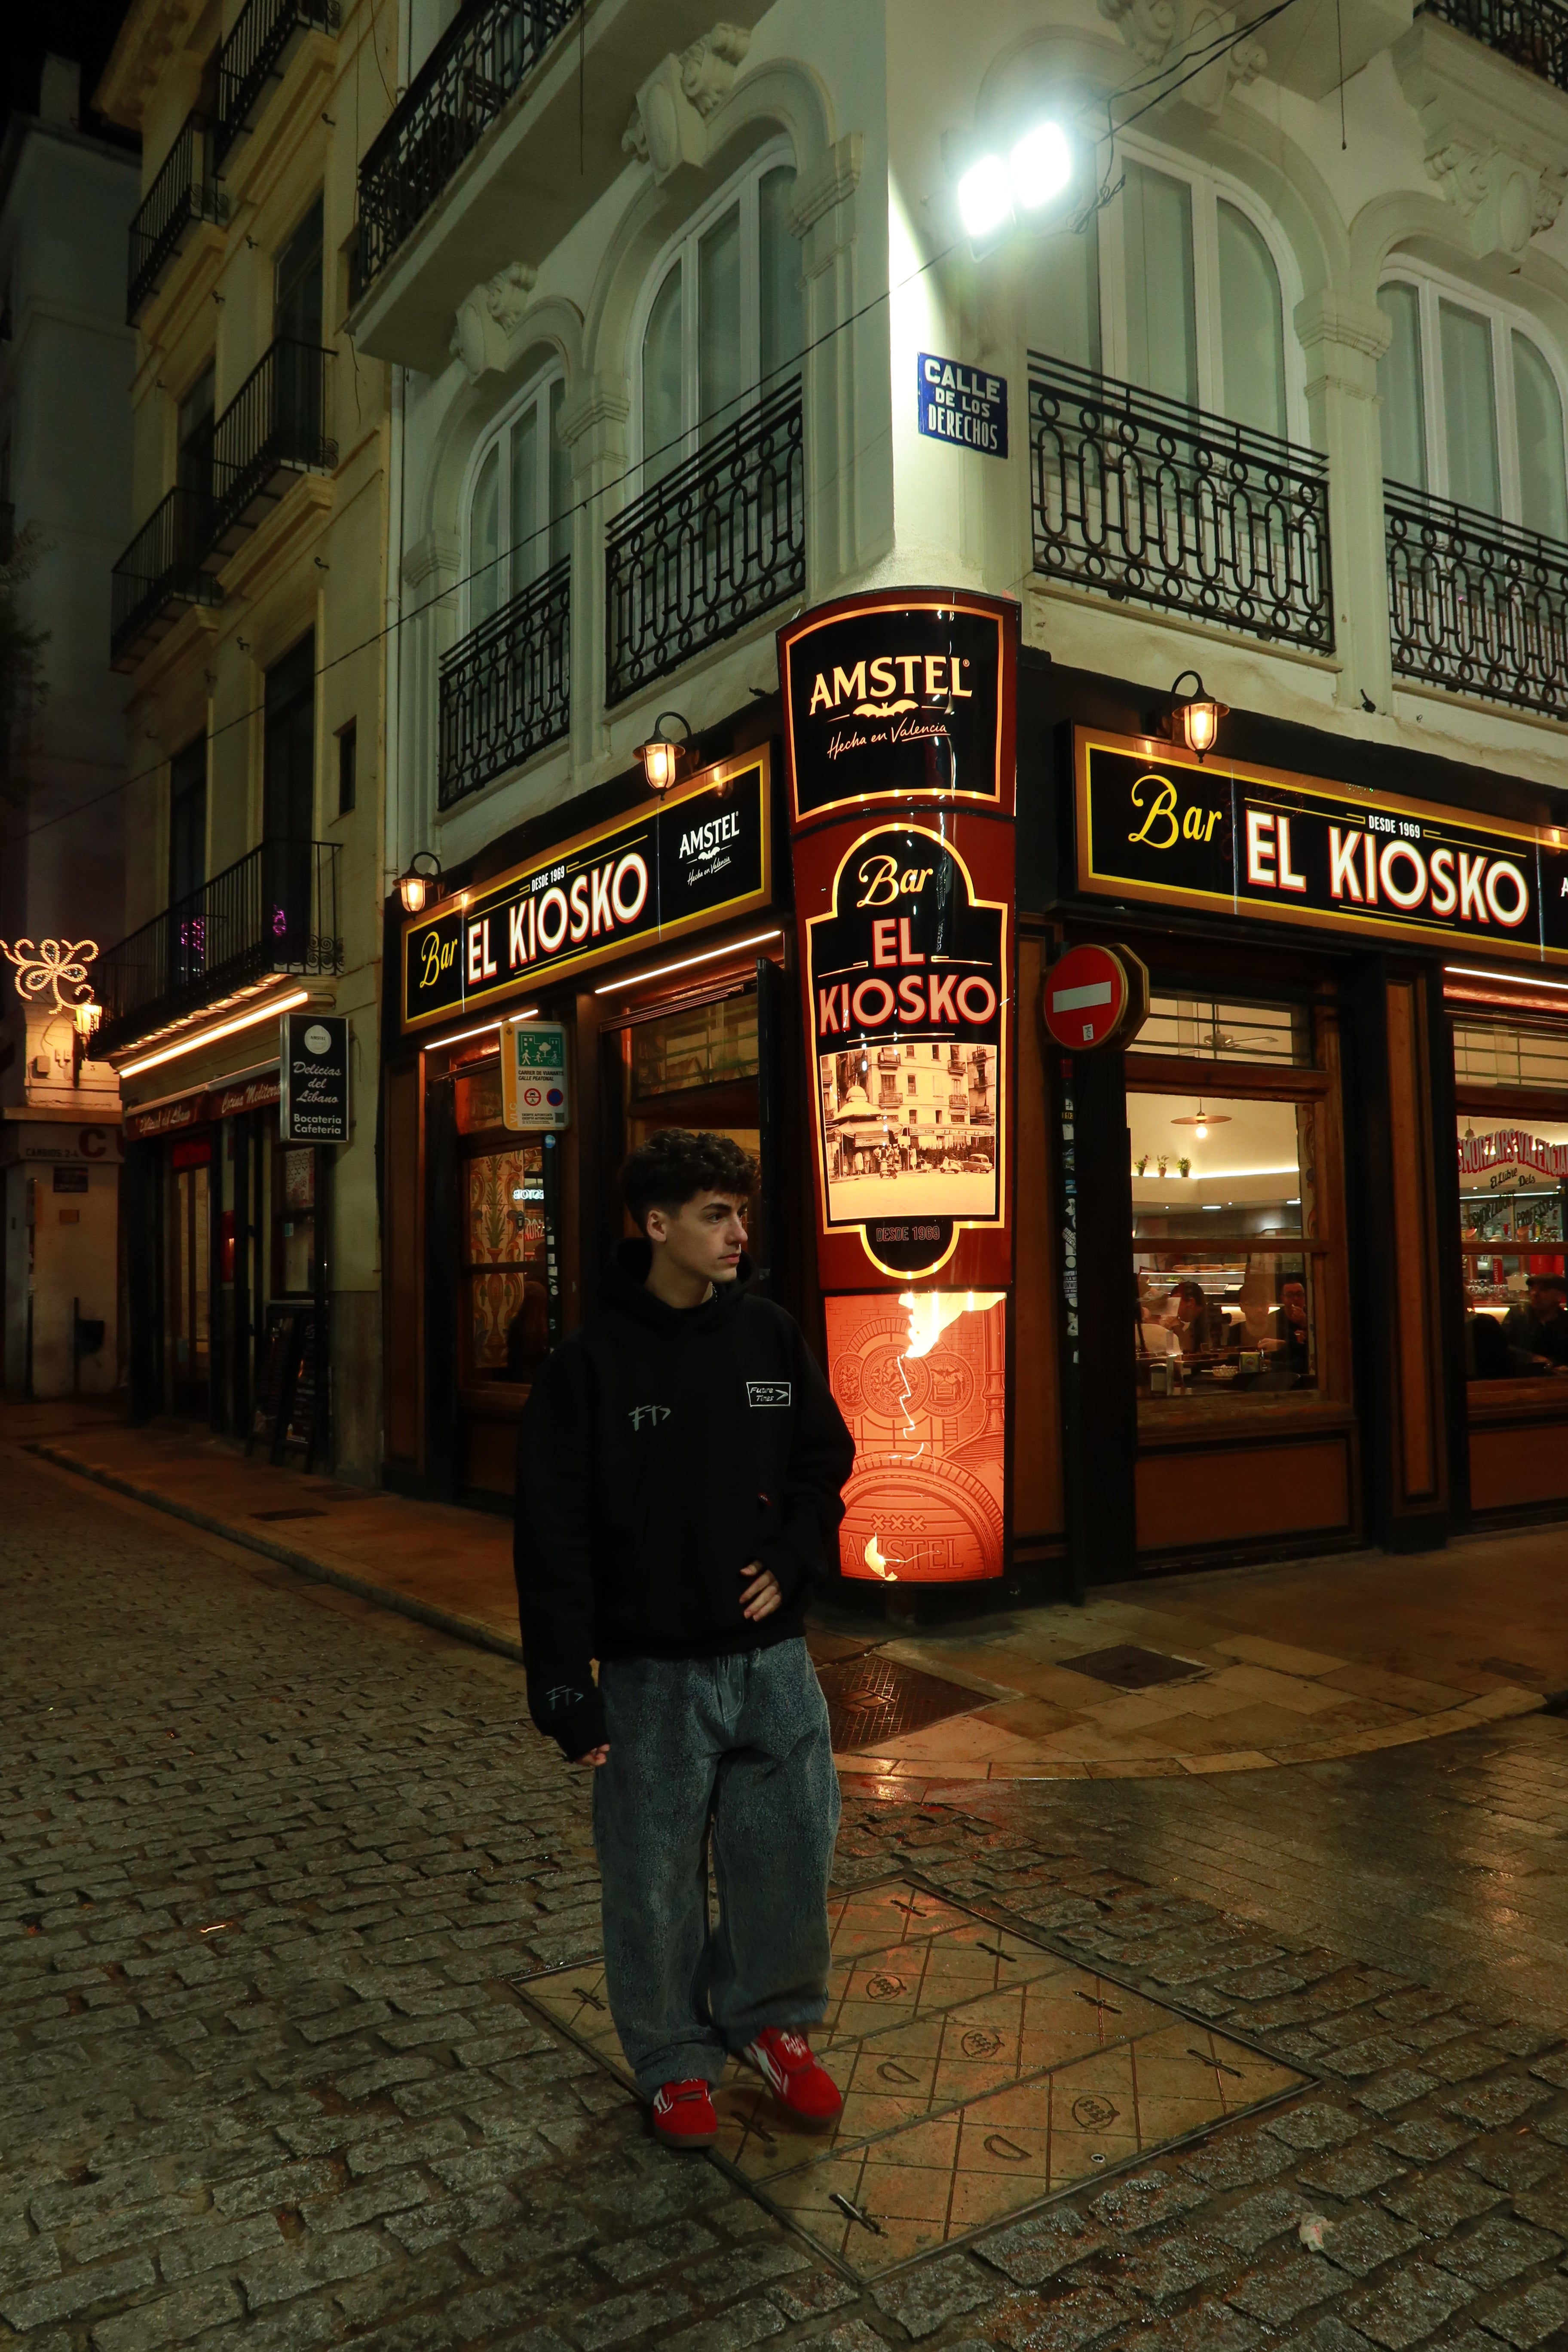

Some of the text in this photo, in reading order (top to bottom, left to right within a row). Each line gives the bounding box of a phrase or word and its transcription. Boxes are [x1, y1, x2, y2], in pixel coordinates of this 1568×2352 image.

[925, 358, 1000, 404] CALLE
[936, 387, 990, 418] DE LOS
[928, 404, 997, 450] DERECHOS
[809, 656, 972, 716] AMSTEL
[827, 717, 947, 760] Hecha en Valencia
[1128, 775, 1222, 848] Bar
[1369, 815, 1421, 839] DESDE 1969
[679, 812, 740, 859] AMSTEL
[532, 865, 565, 892] DESDE 1969
[687, 869, 703, 886] Hecha
[711, 856, 731, 873] Valencia
[857, 855, 933, 907] Bar
[1246, 809, 1529, 927] EL KIOSKO
[468, 853, 648, 986] EL KIOSKO
[420, 931, 458, 988] Bar
[873, 917, 925, 968] EL
[819, 974, 997, 1037] KIOSKO
[293, 1061, 342, 1076] Delicias
[308, 1078, 327, 1088] del
[294, 1114, 342, 1124] Bocatería
[294, 1124, 341, 1134] Cafetería
[26, 1148, 61, 1157] CAMBIOS
[876, 1225, 940, 1242] DESDE 1969
